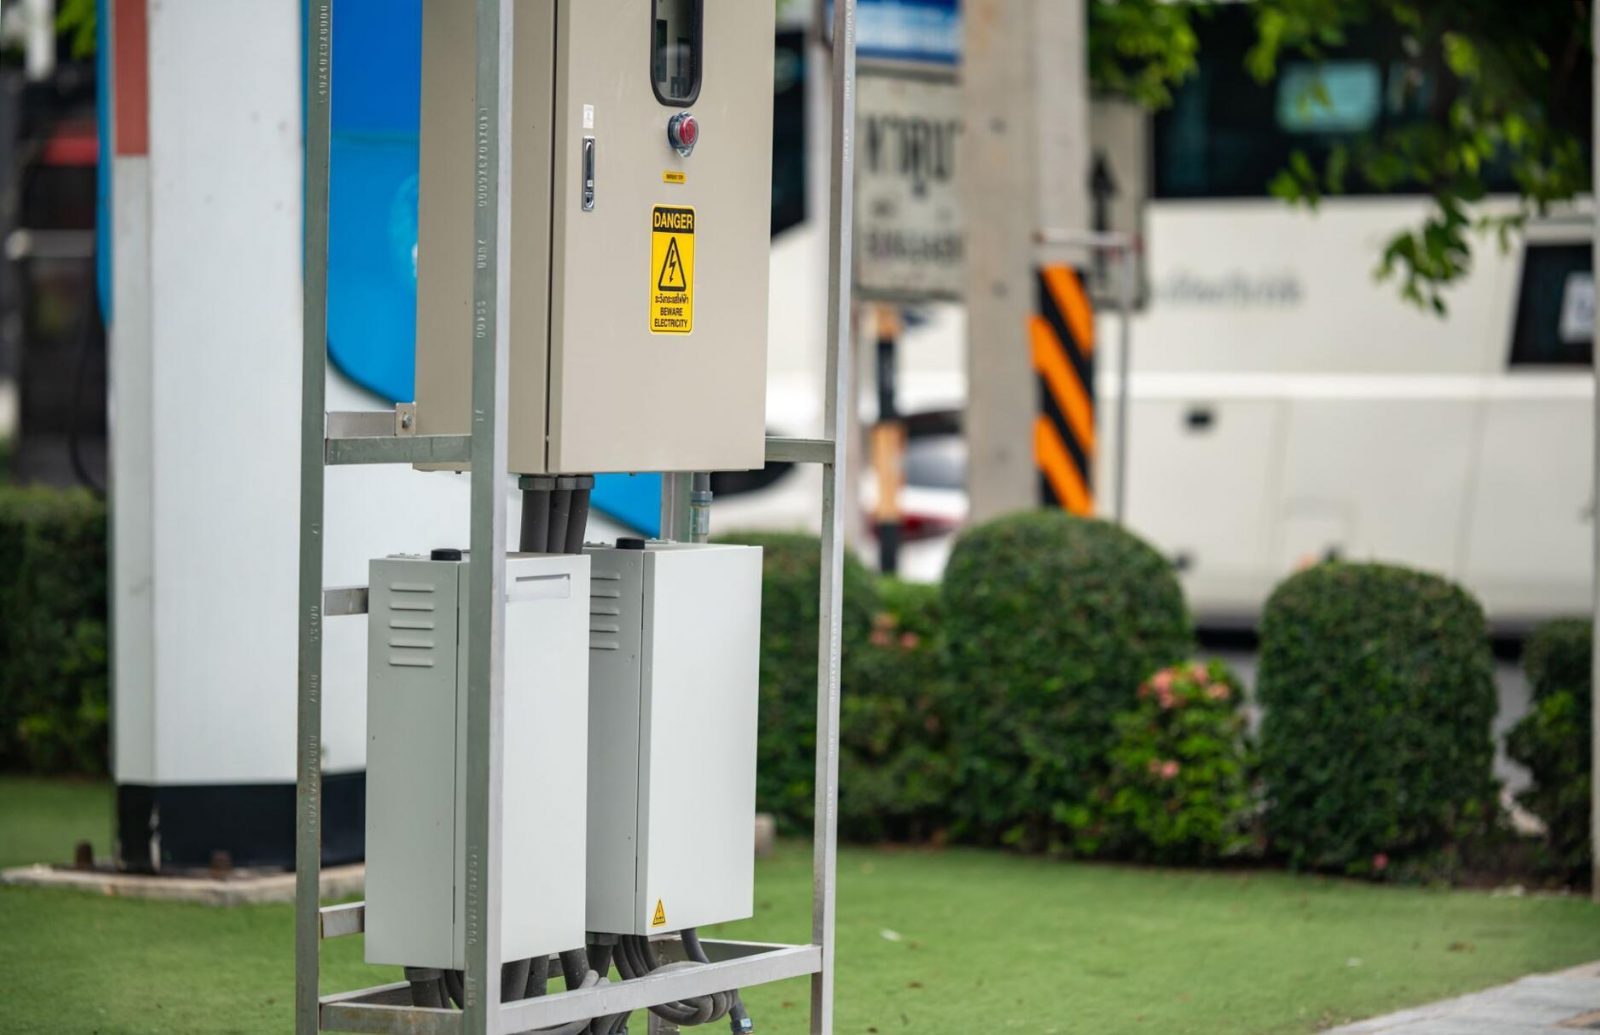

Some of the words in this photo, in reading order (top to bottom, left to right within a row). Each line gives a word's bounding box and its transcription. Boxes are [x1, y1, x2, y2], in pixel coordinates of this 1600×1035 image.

[653, 210, 694, 231] DANGER
[660, 307, 683, 317] BEWARE
[654, 318, 688, 330] ELECTRICITY
